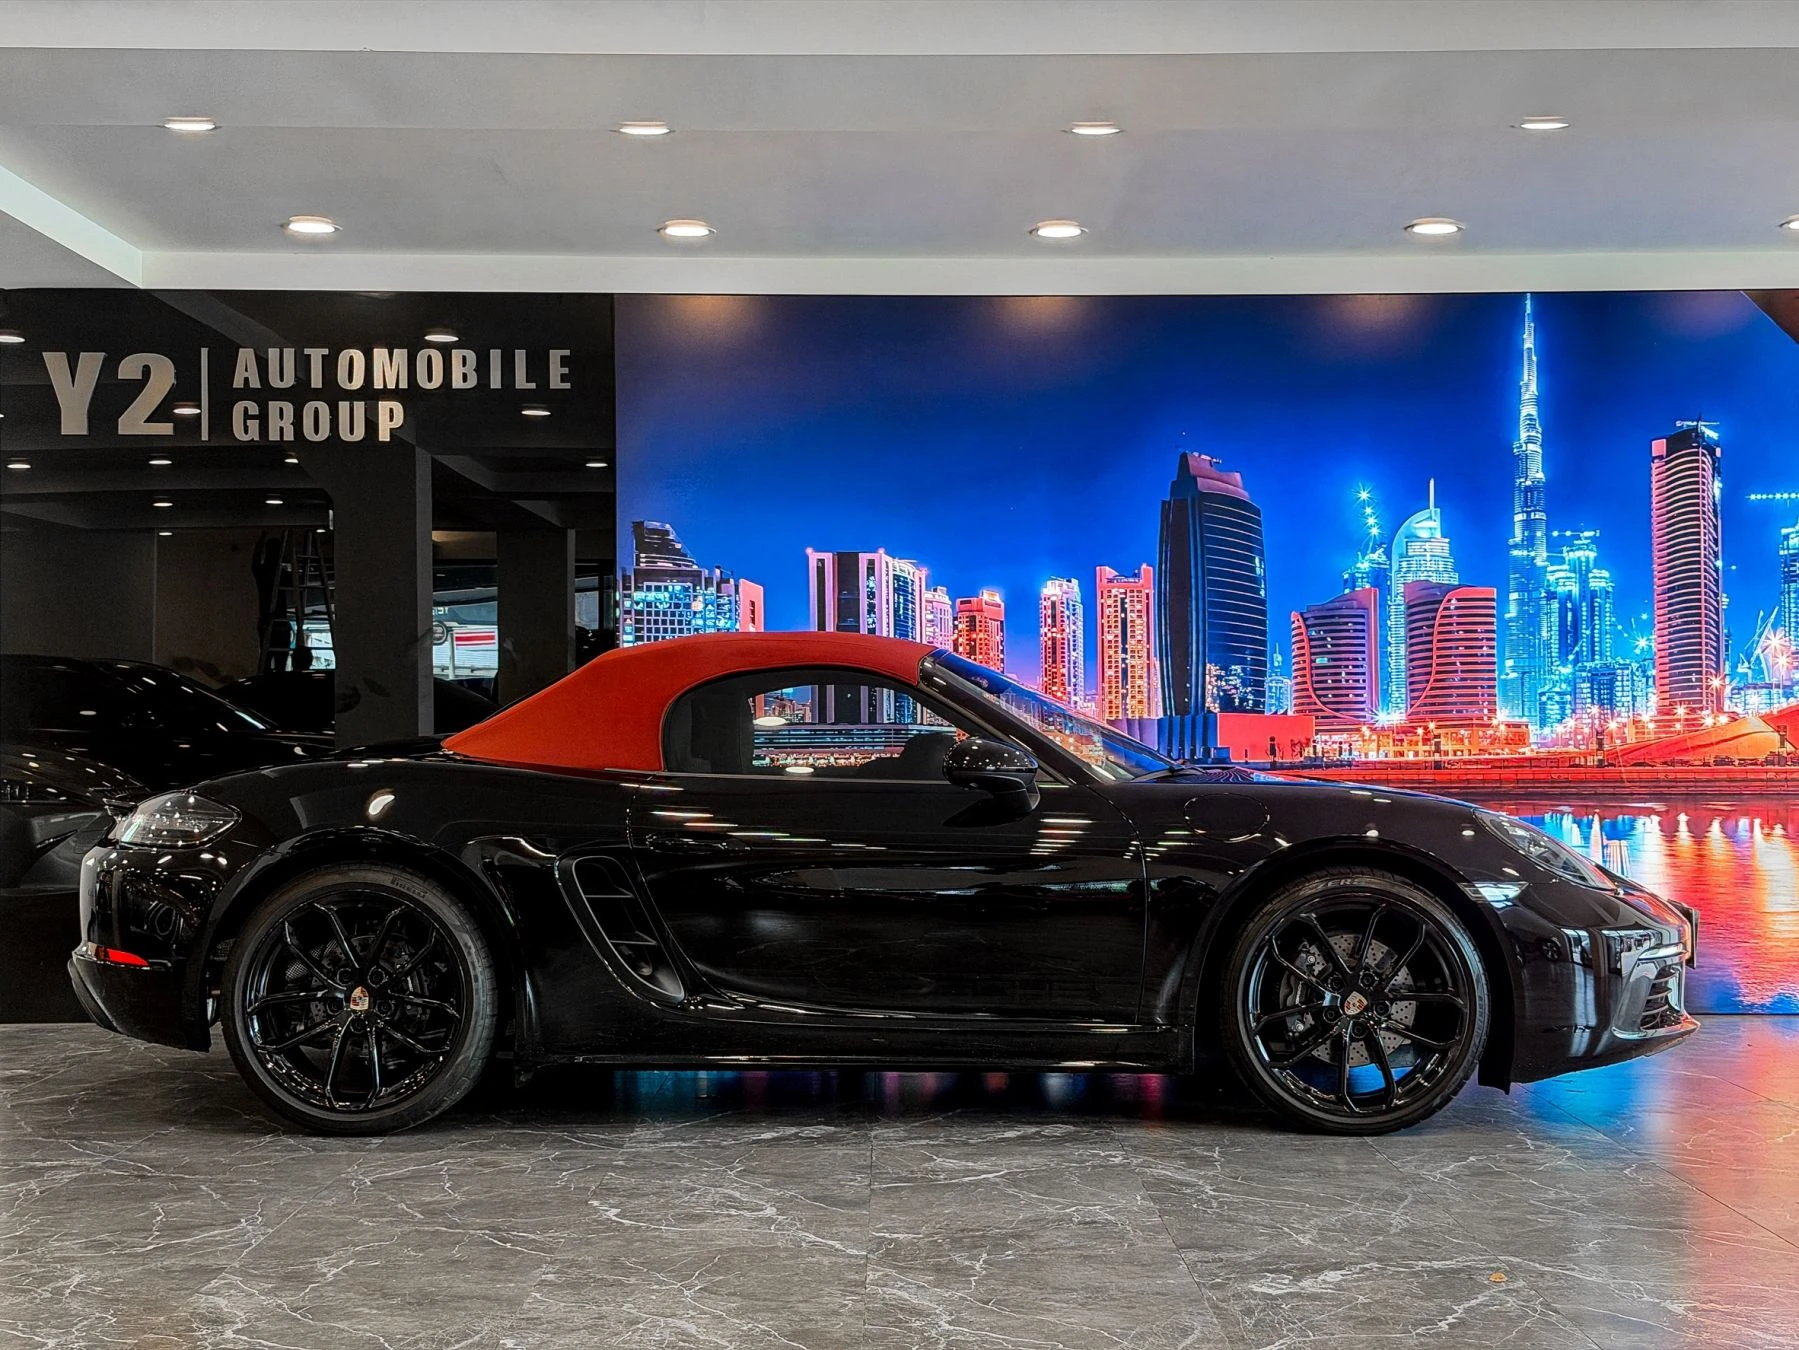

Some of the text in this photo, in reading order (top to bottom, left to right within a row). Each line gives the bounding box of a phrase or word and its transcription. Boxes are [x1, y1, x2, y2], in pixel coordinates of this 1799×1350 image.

[232, 347, 572, 390] AUTOMOBILE
[42, 351, 175, 436] Y2
[232, 400, 405, 442] GROUP
